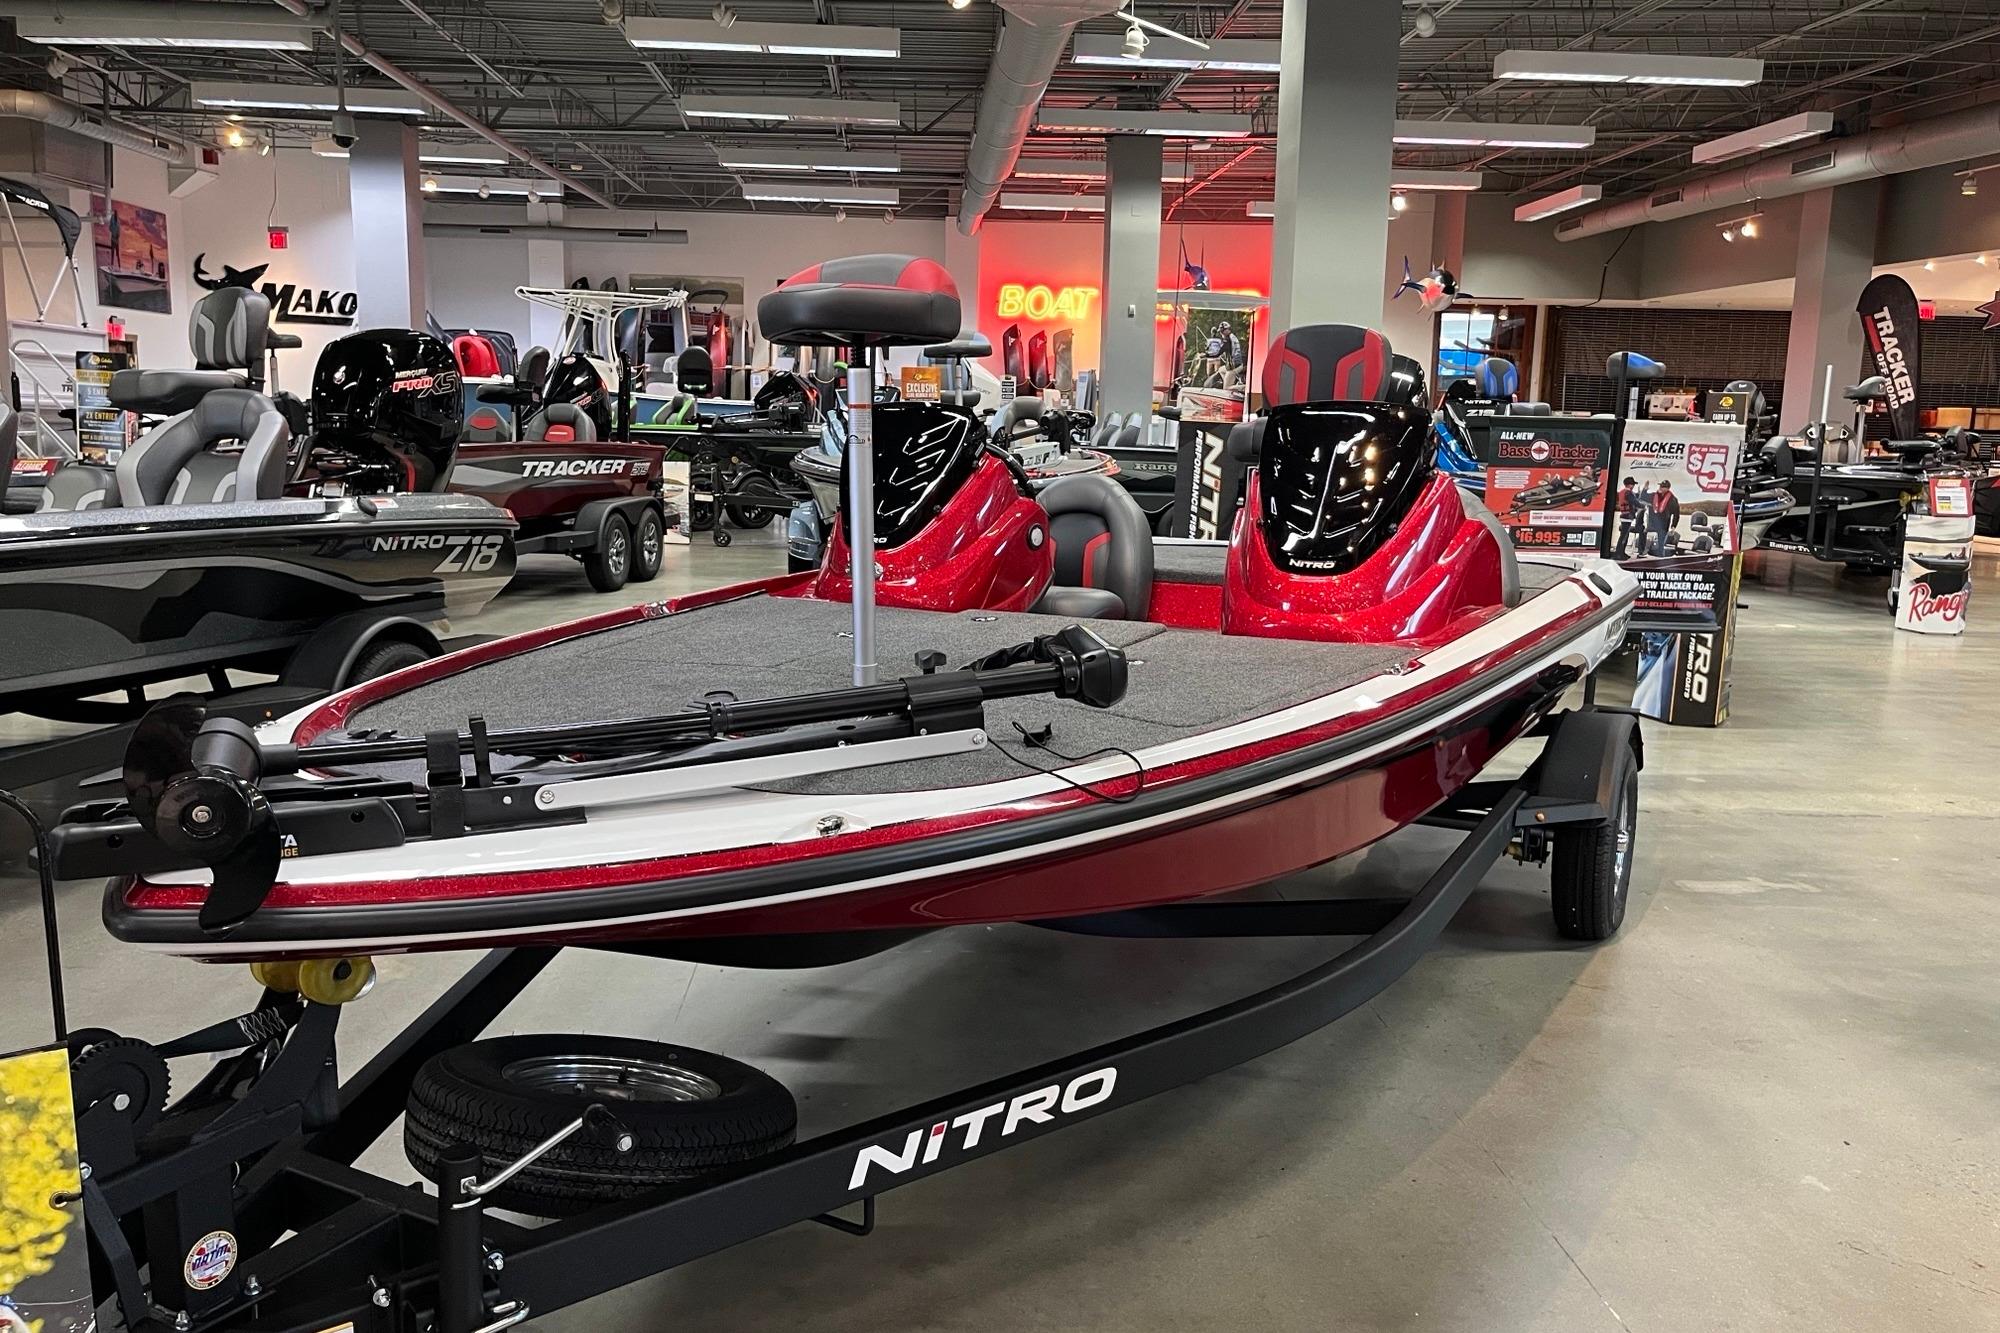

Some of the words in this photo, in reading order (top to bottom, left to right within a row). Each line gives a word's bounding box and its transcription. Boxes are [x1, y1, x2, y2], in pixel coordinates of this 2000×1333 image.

[260, 283, 358, 327] MAKO
[997, 284, 1099, 320] BOAT
[1873, 306, 1916, 405] TRACKER
[395, 368, 428, 379] MERCURY
[1876, 353, 1889, 376] OFF
[1884, 378, 1900, 410] ROAD
[906, 383, 938, 393] EXCLUSIVE
[1500, 431, 1535, 440] ALL-NEW
[1498, 442, 1531, 458] Bass
[1549, 442, 1600, 459] Tracker
[1624, 440, 1686, 454] TRACKER
[522, 459, 626, 478] TRACKER
[1133, 462, 1178, 473] Rang
[1191, 429, 1204, 513] PERFORMANCE
[1687, 452, 1727, 489] $5
[1515, 529, 1562, 544] $16,995
[432, 534, 504, 573] Z18
[1645, 571, 1666, 581] YOUR
[1666, 572, 1684, 581] VERY
[1684, 573, 1703, 582] OWN
[1640, 581, 1658, 589] NEW
[1660, 581, 1692, 591] TRACKER
[1693, 582, 1716, 592] BOAT,
[1646, 590, 1678, 599] TRAILER
[1679, 591, 1715, 600] PACKAGE.
[1908, 582, 1969, 623] Rang
[1686, 636, 1697, 670] FISHING
[1683, 670, 1693, 699] BOATS
